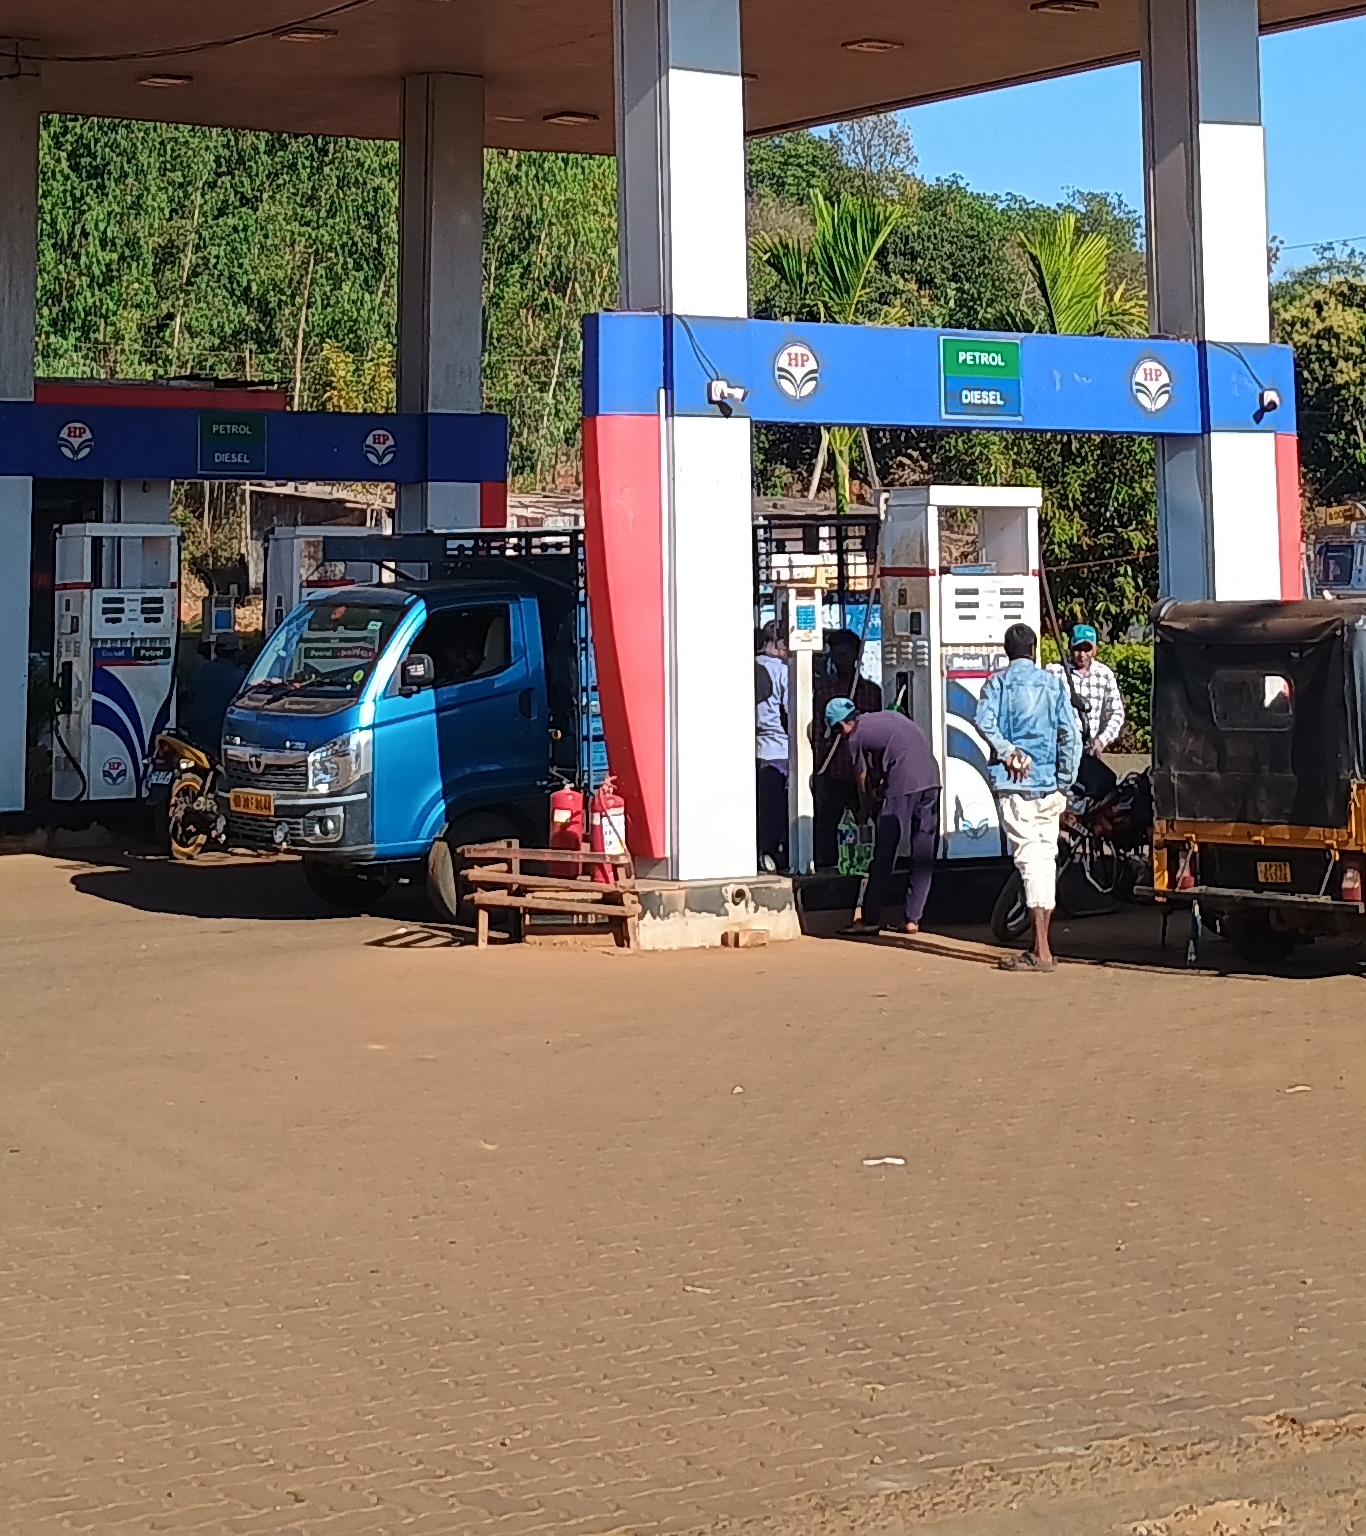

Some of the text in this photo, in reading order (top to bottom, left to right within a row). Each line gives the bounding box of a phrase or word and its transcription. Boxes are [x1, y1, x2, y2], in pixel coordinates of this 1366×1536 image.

[787, 352, 810, 368] HP
[958, 351, 1006, 366] PETROL
[1143, 368, 1163, 381] HP
[961, 389, 1005, 406] DIESEL
[67, 426, 87, 438] HP
[212, 424, 253, 435] PETROL
[372, 434, 390, 445] HP
[214, 452, 251, 464] DIESEL
